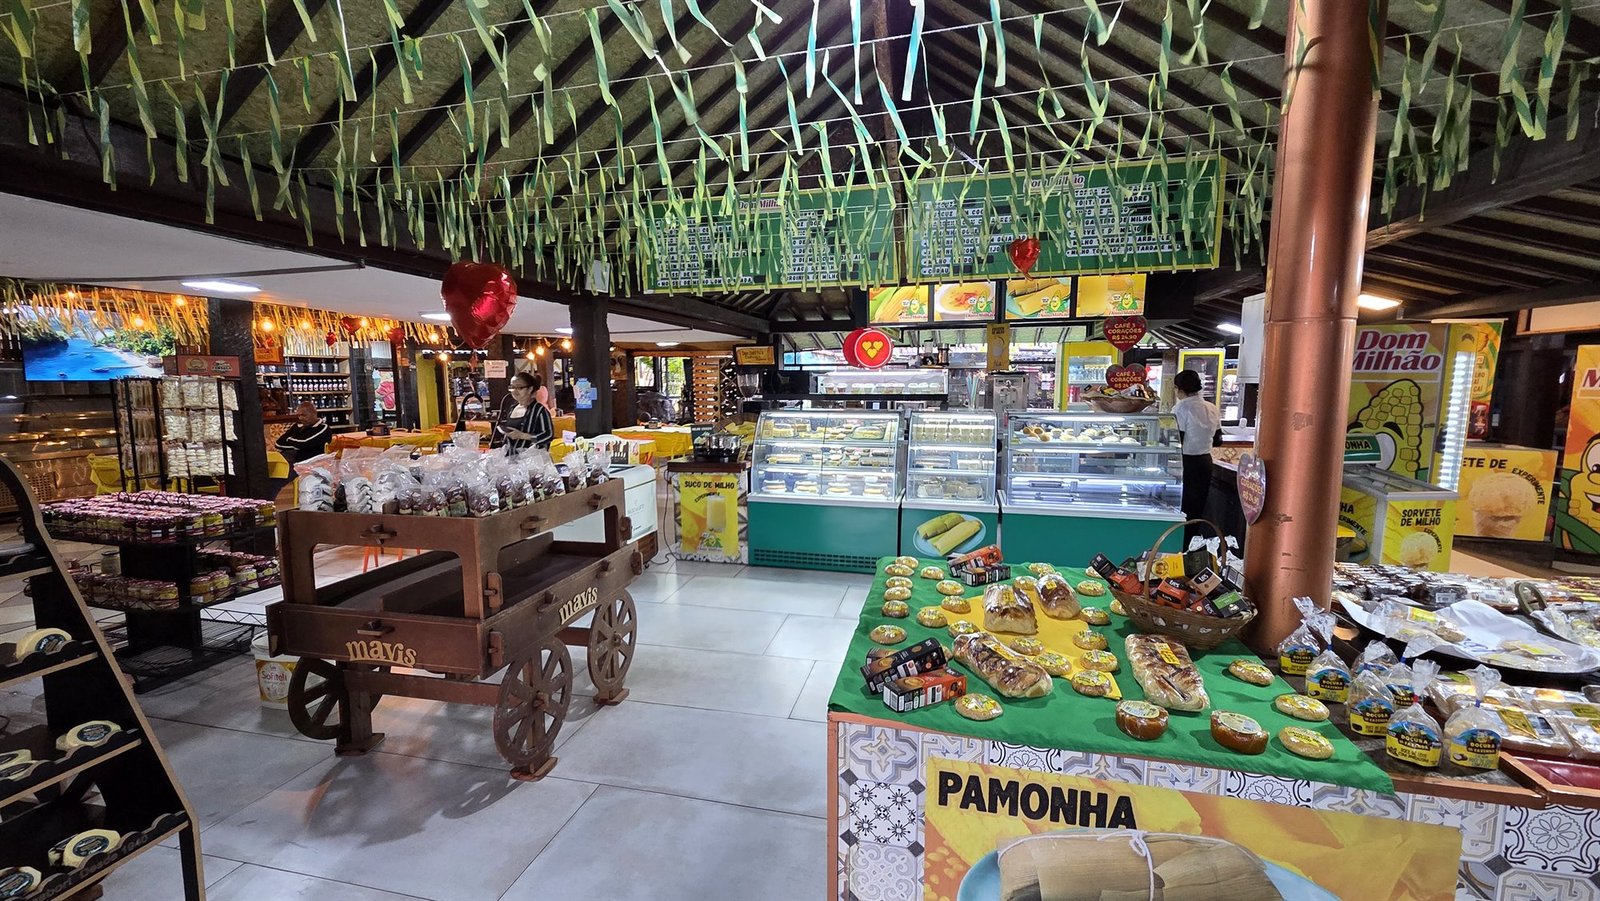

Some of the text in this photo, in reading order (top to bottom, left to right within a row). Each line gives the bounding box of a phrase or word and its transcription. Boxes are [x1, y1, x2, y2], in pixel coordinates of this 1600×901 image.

[1356, 330, 1428, 350] Dom
[1489, 458, 1508, 469] DE
[684, 480, 702, 488] SUCO
[714, 482, 735, 490] MILHO
[1512, 467, 1546, 505] EXPERIMENTE
[1400, 518, 1441, 527] DE MILHO
[1402, 508, 1442, 518] SORVETE
[558, 587, 598, 625] mavis
[346, 640, 417, 668] mavis
[938, 770, 1138, 830] PAMONHA
